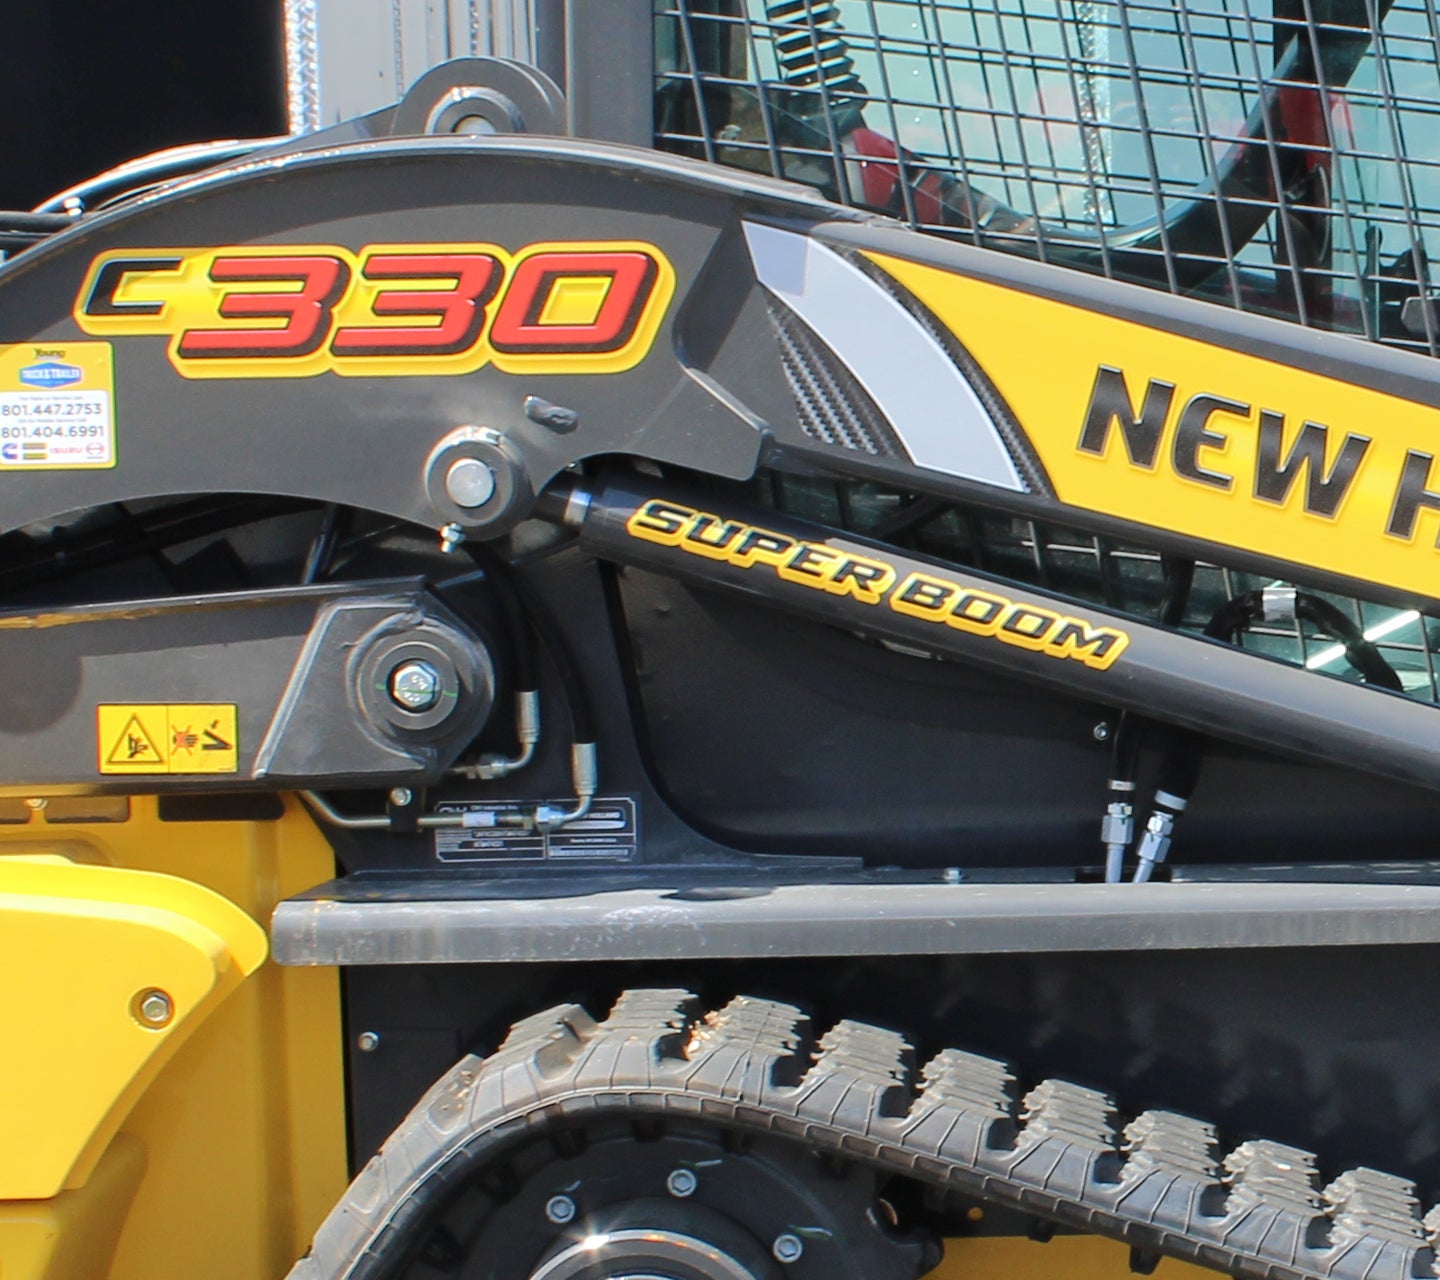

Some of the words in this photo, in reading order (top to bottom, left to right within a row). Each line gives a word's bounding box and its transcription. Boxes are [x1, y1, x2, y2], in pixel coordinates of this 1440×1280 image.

[1, 403, 103, 416] 801.447.2753
[1, 426, 104, 439] 801.404.6991
[1076, 363, 1372, 521] NEW
[630, 500, 889, 600] SUPER
[895, 577, 1123, 664] BOOM
